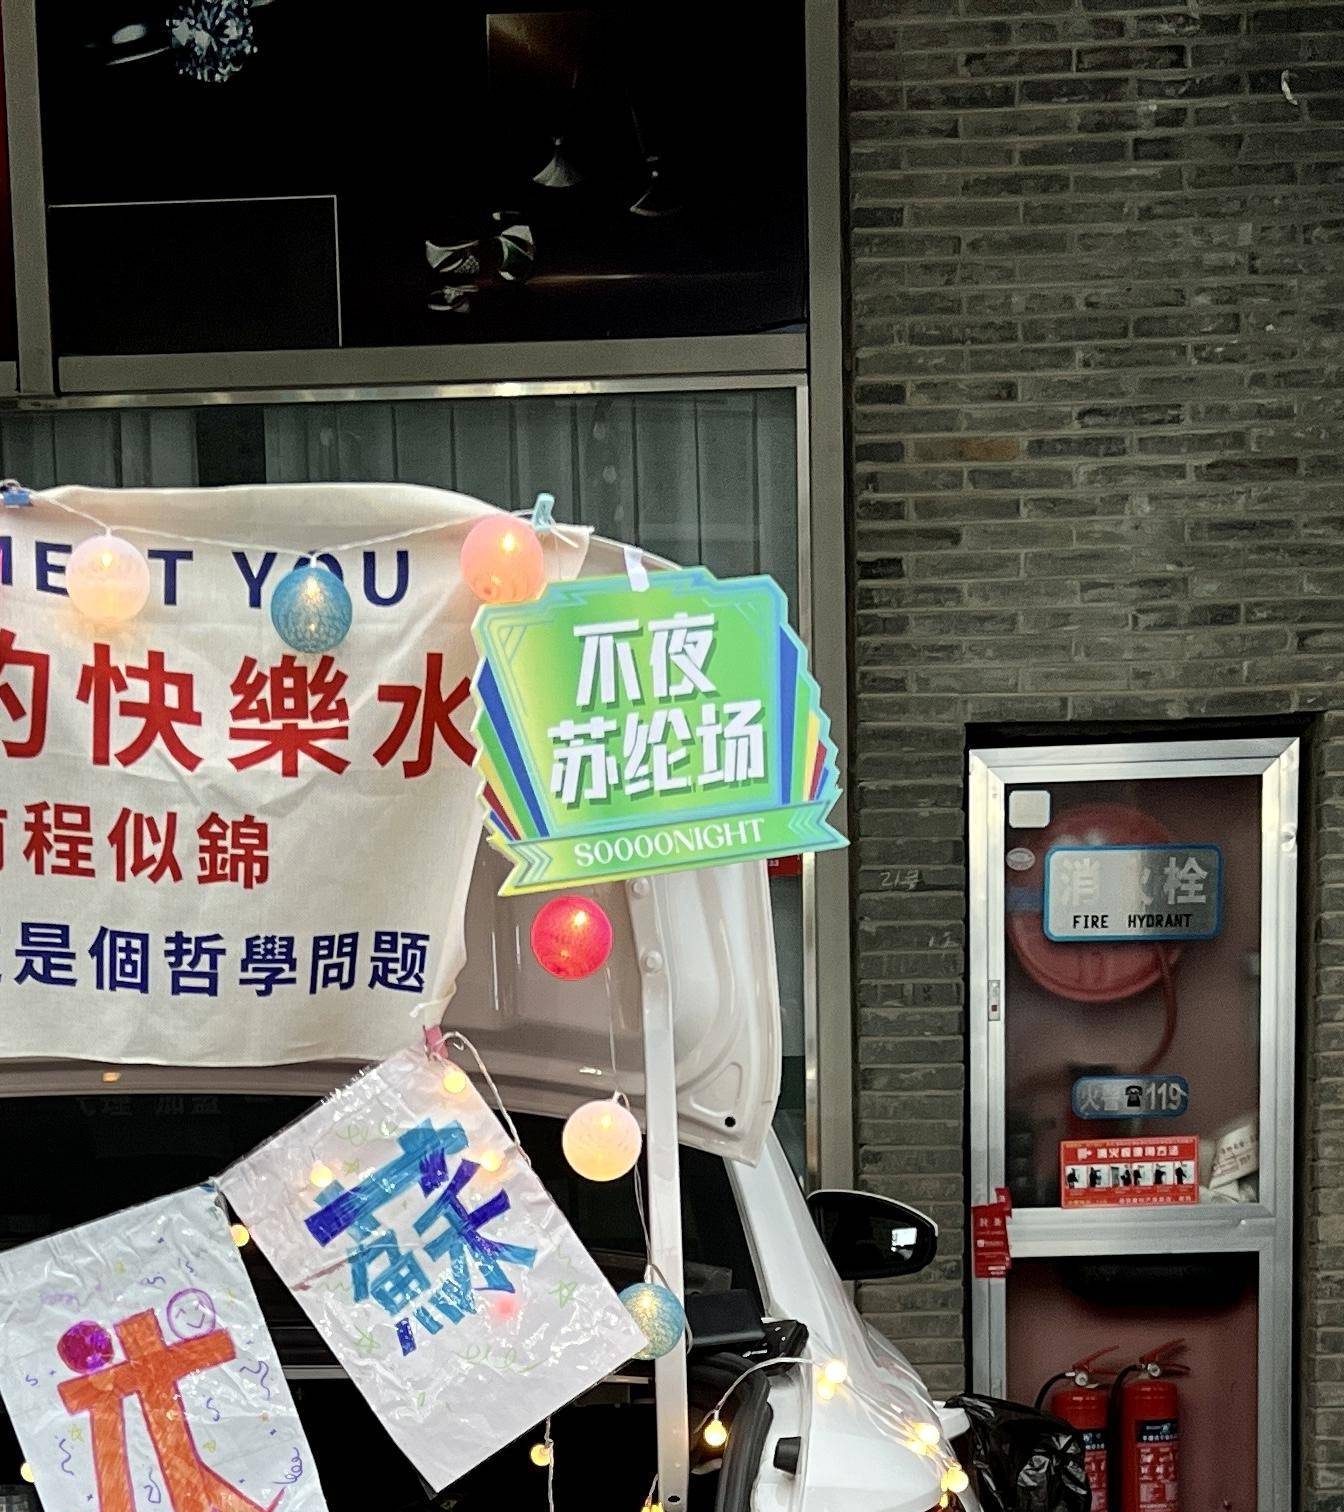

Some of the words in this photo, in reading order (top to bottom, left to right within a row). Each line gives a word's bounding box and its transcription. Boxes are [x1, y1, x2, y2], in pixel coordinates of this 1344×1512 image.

[232, 549, 410, 609] YU
[572, 611, 720, 707] 不夜
[547, 698, 767, 806] 苏纶场
[573, 817, 766, 868] SOOOONIGHT
[1072, 914, 1109, 929] FIRE
[1127, 913, 1194, 929] HYDRANT
[1145, 1081, 1187, 1111] 119
